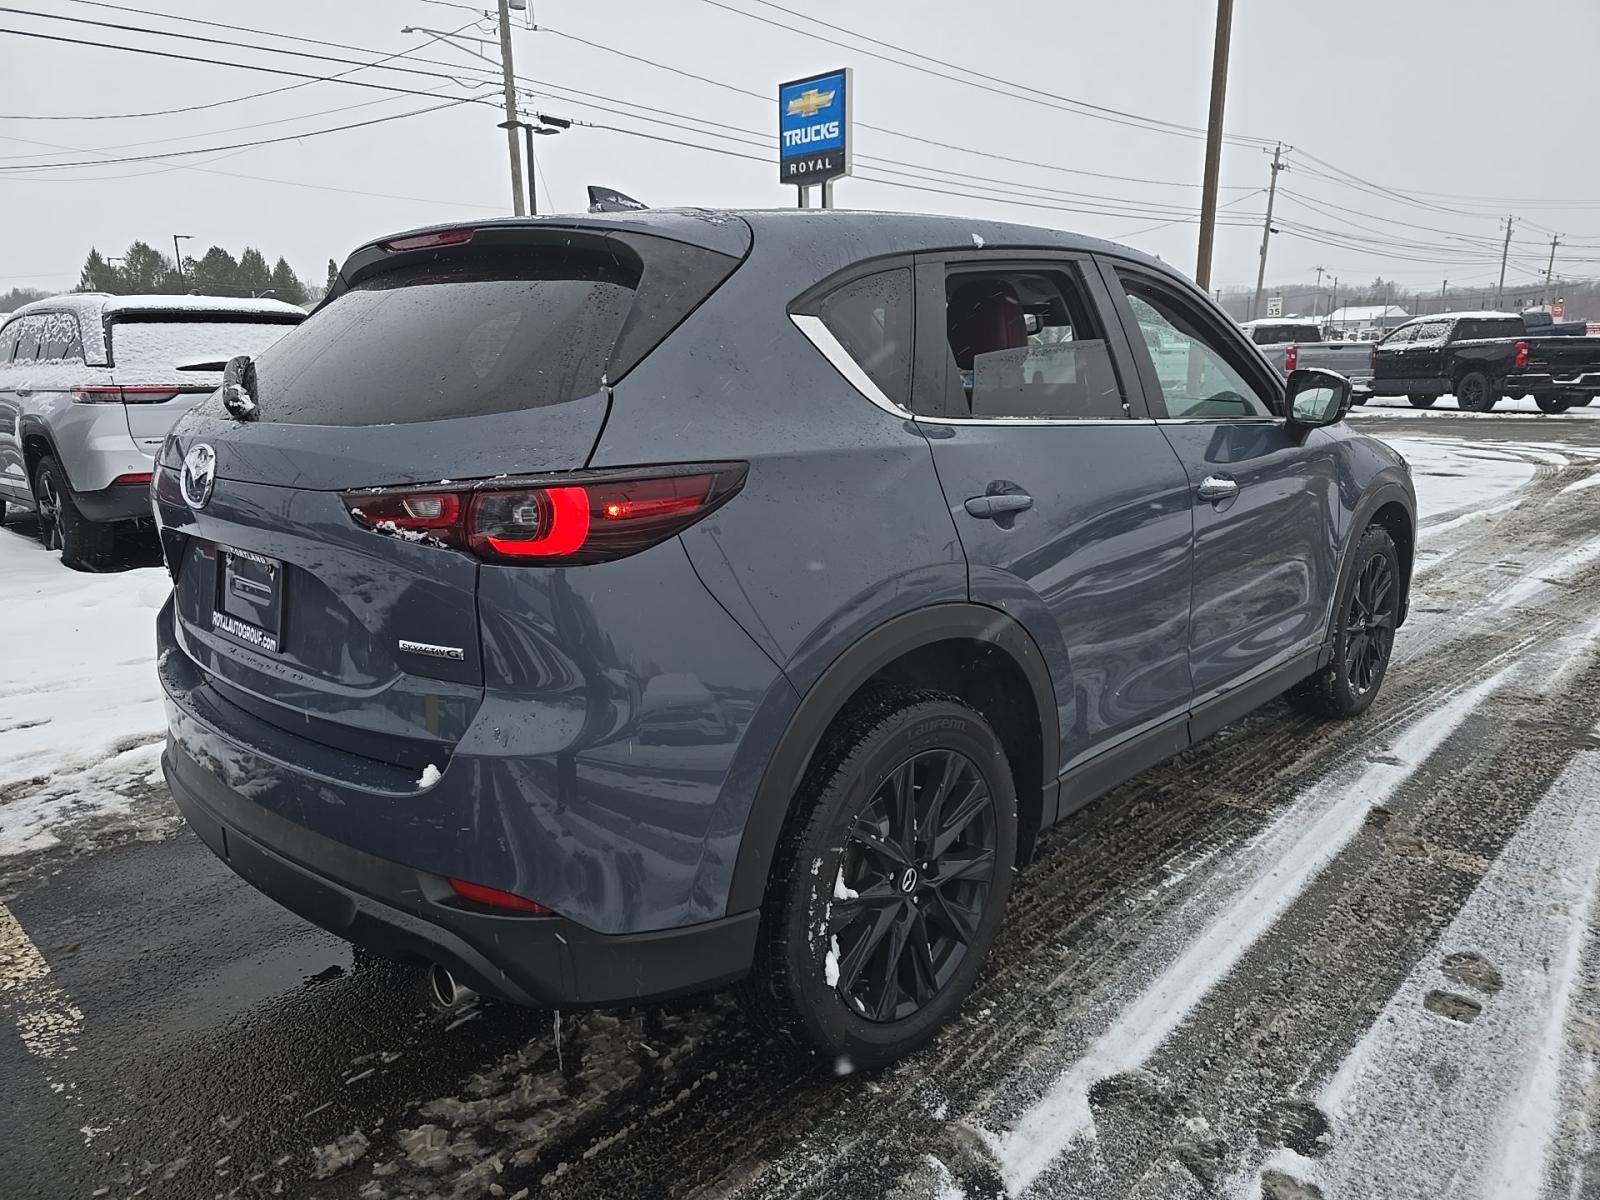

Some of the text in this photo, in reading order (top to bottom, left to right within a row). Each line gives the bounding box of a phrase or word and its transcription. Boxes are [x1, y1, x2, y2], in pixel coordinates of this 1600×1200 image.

[783, 121, 840, 147] TRUCKS
[790, 157, 832, 175] ROYAL
[1268, 308, 1280, 316] 35
